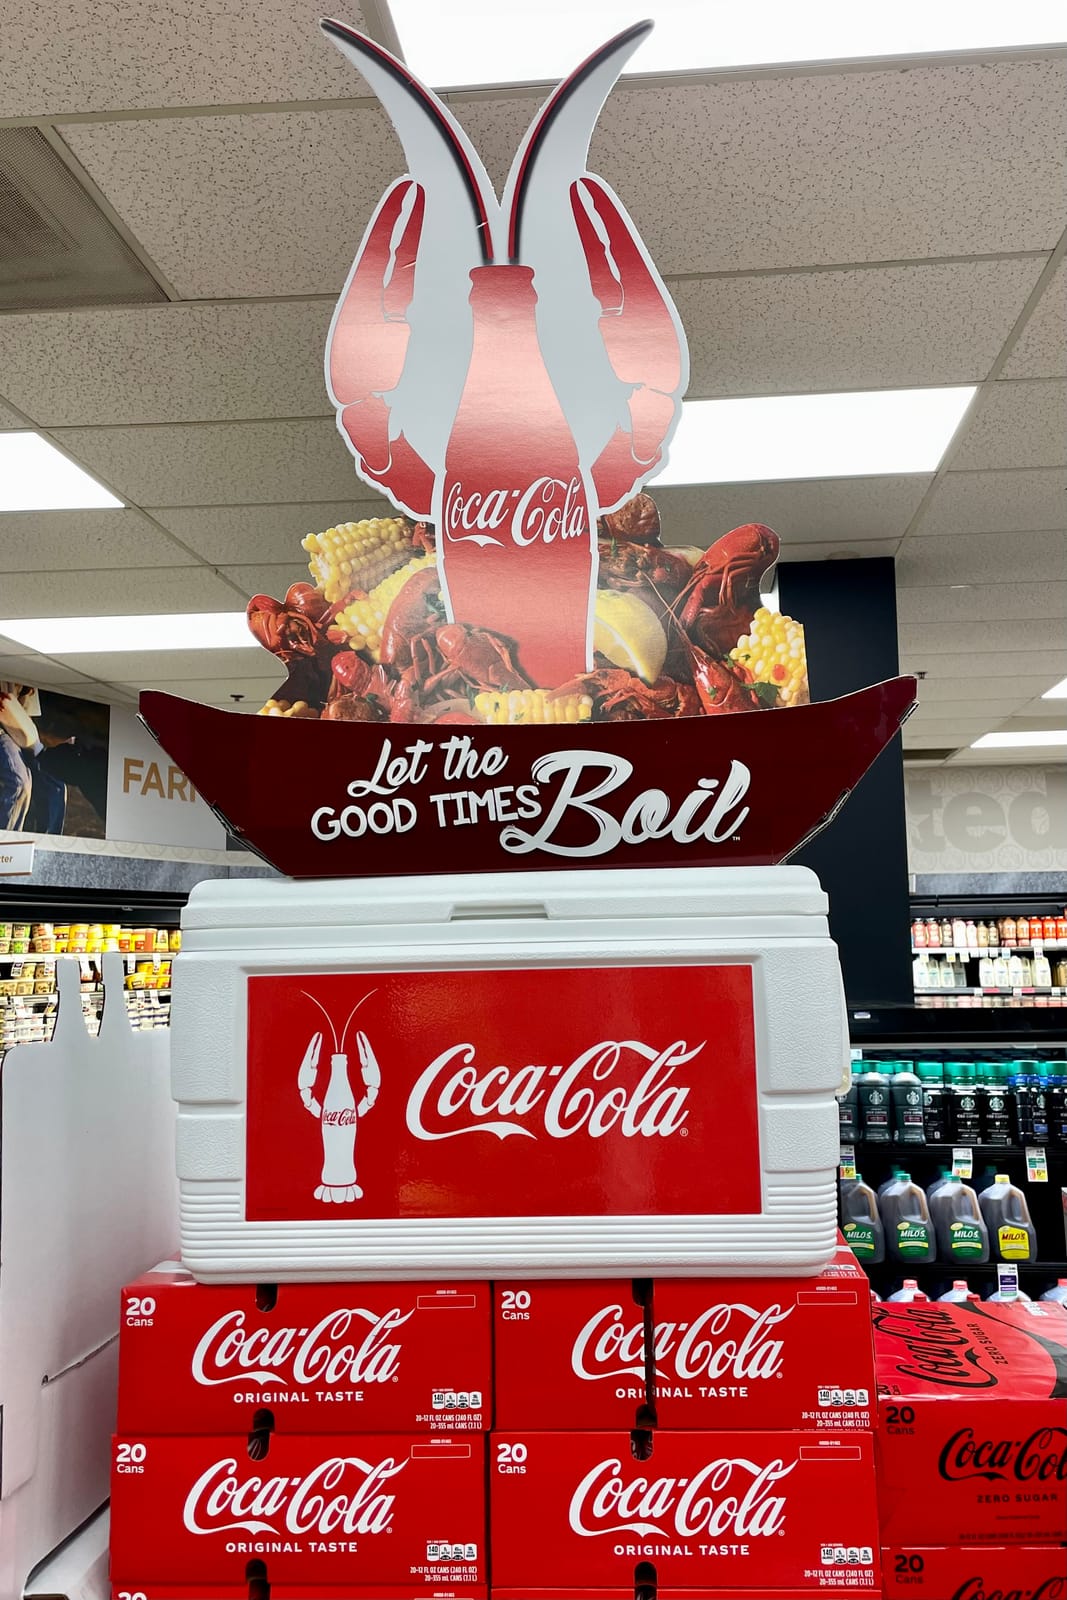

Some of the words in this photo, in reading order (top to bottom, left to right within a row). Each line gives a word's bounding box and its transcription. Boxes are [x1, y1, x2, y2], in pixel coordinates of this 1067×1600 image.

[444, 477, 586, 547] Coca-Cola
[347, 738, 434, 798] Let
[439, 735, 509, 781] the
[123, 757, 196, 803] FAR
[311, 798, 418, 841] GOOD
[429, 784, 542, 828] TIMES
[500, 750, 751, 858] Boil
[405, 1040, 707, 1141] Coca-Cola
[126, 1297, 156, 1316] 20
[501, 1290, 531, 1309] 20
[126, 1317, 154, 1327] Cans
[502, 1311, 530, 1320] Cans
[966, 1322, 993, 1346] SUGAR
[191, 1308, 416, 1386] Coca-Cola
[872, 1306, 999, 1389] Coca-Cola
[985, 1346, 1009, 1366] ZERO
[233, 1391, 309, 1403] ORIGINAL
[316, 1391, 364, 1402] TASTE
[615, 1387, 692, 1399] ORIINAL
[699, 1386, 748, 1397] TASTE
[886, 1406, 915, 1424] 20
[887, 1426, 915, 1435] Cans
[116, 1443, 147, 1463] 20
[497, 1443, 528, 1463] 20
[117, 1464, 144, 1474] Cans
[498, 1464, 526, 1474] Cans
[183, 1457, 410, 1535] Coca-Cola
[568, 1458, 799, 1538] Coca-Cola
[977, 1494, 1010, 1504] ZERO
[1015, 1493, 1058, 1503] SUGAR
[225, 1542, 302, 1553] ORIGINAL
[308, 1542, 357, 1552] TASTE
[613, 1545, 693, 1556] ORIGINAL
[699, 1545, 750, 1555] TASTE
[895, 1555, 924, 1573] 20
[895, 1575, 924, 1584] Cans
